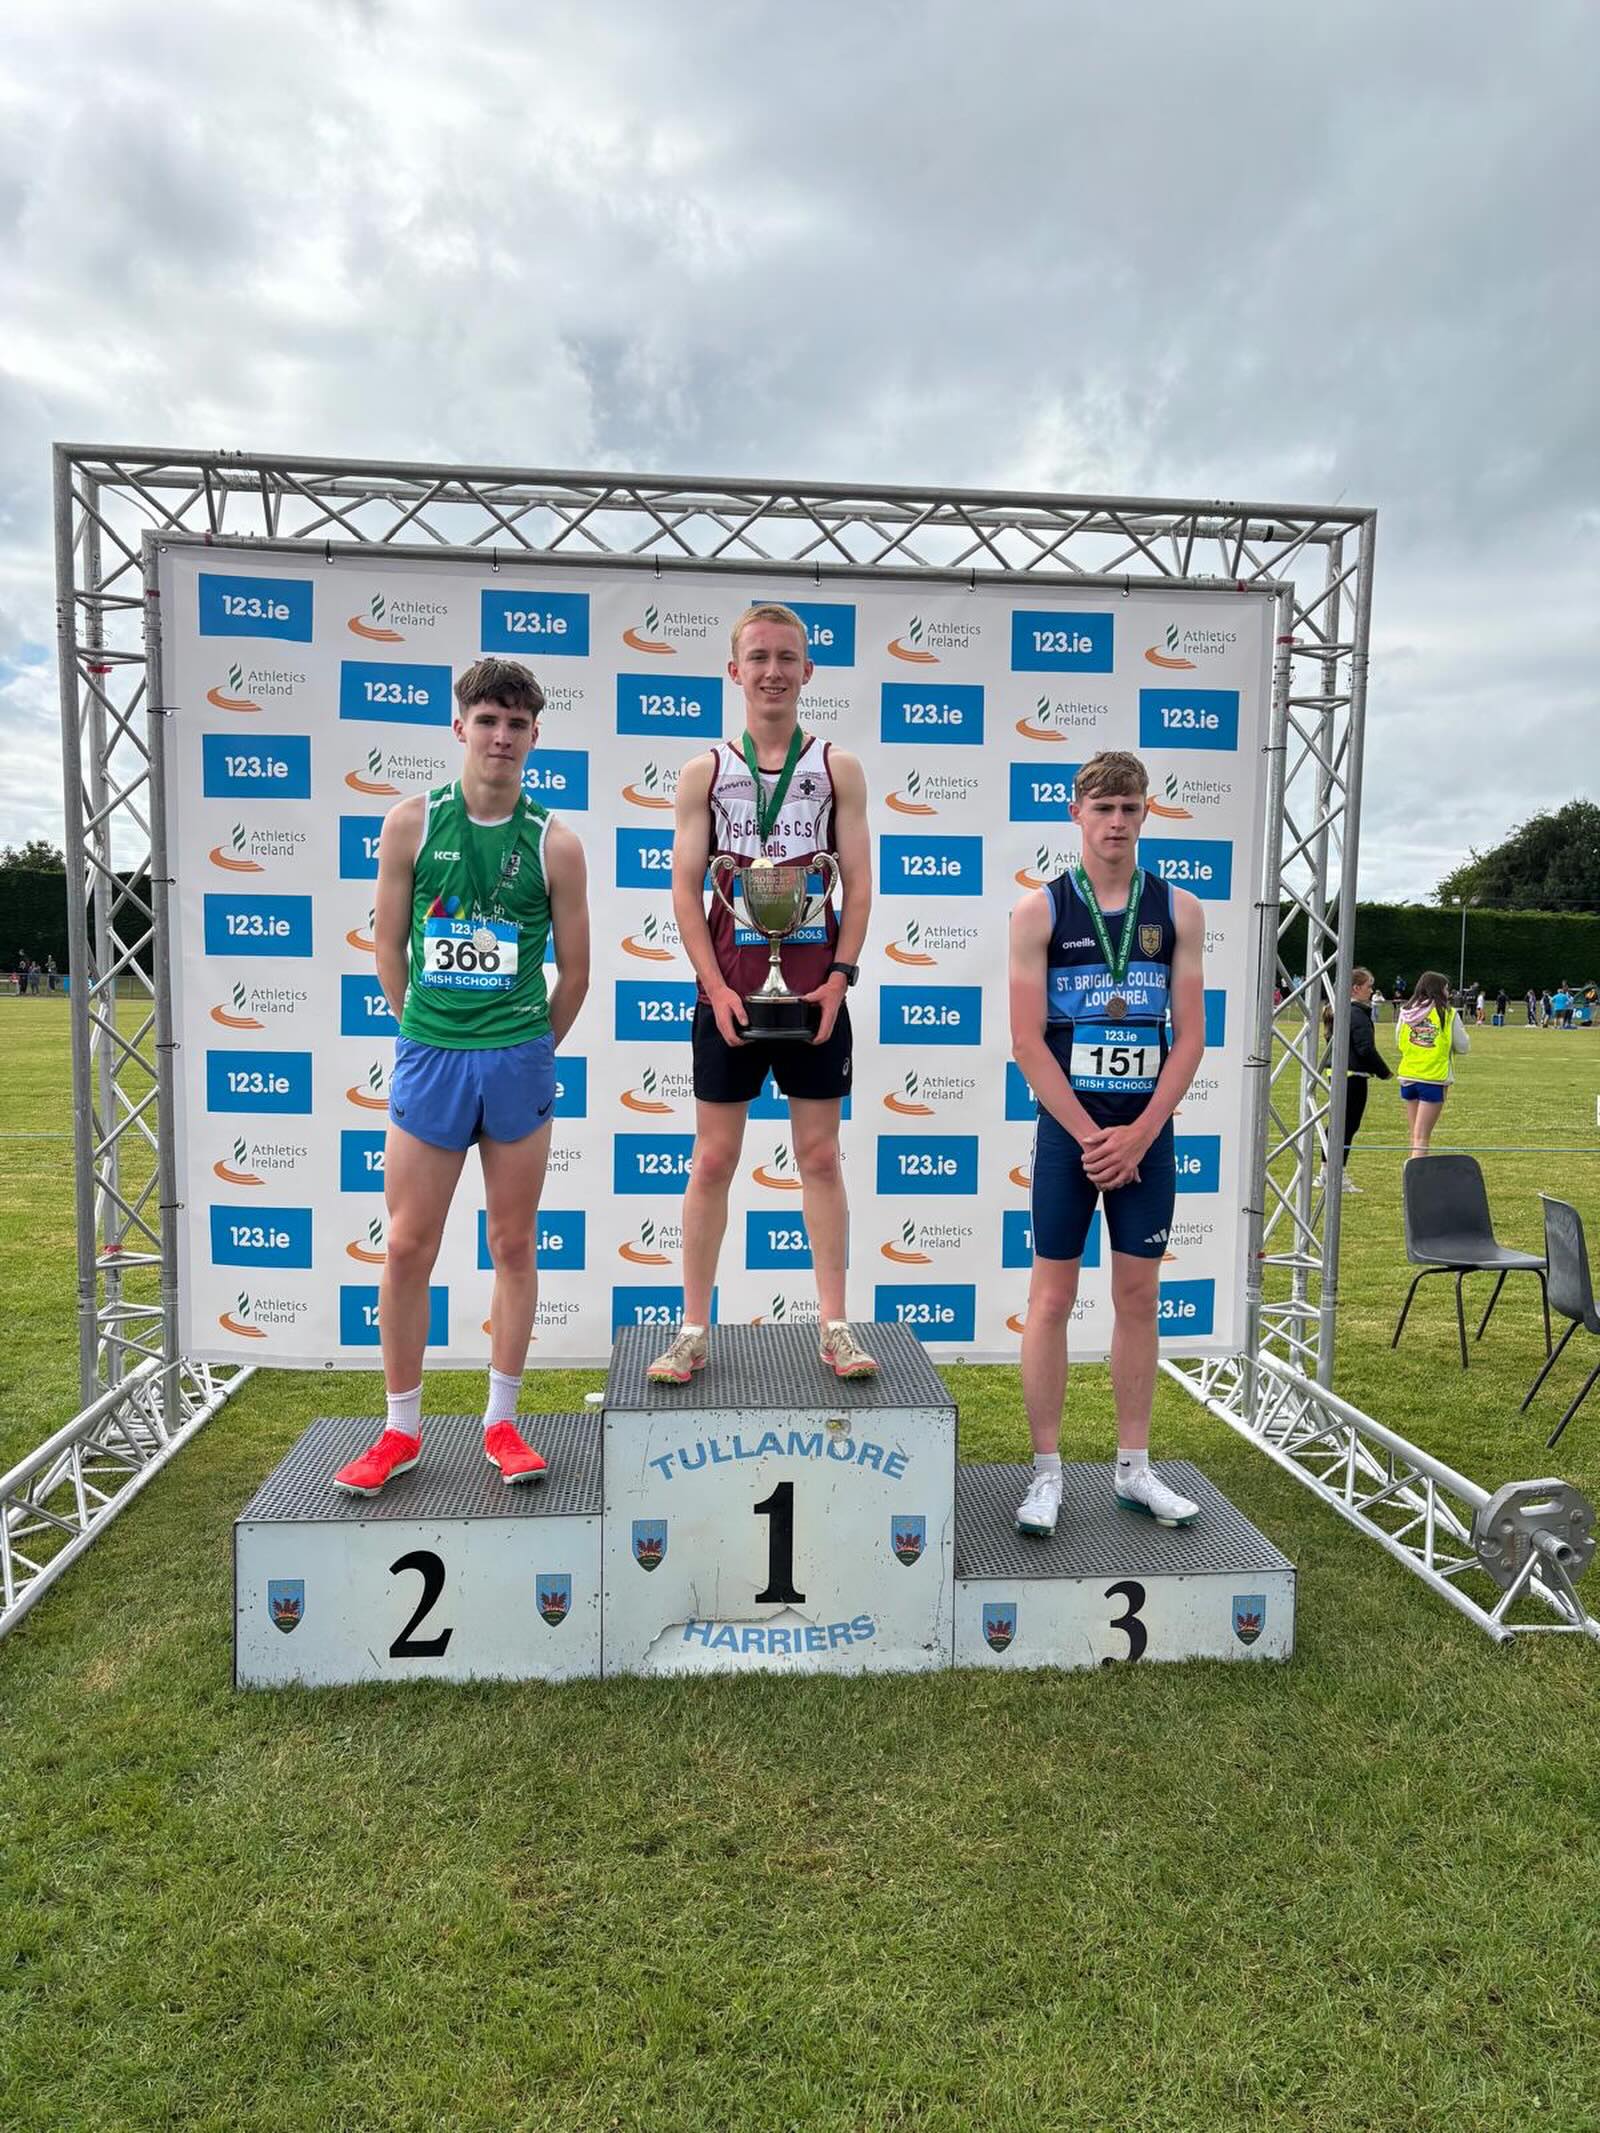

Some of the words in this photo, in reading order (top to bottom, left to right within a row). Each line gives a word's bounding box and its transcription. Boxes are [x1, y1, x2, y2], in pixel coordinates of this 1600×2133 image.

[222, 595, 290, 620] 123.ie
[390, 601, 448, 615] Athletics
[390, 615, 435, 626] Ireland
[504, 611, 568, 634] 123.ie
[663, 612, 719, 626] Athletics
[663, 626, 707, 638] Ireland
[808, 624, 834, 645] .ie
[927, 622, 981, 635] Athletics
[927, 636, 969, 648] Ireland
[1032, 631, 1093, 653] 123.ie
[1183, 630, 1237, 642] Athletics
[1183, 643, 1225, 654] Ireland
[248, 671, 306, 684] Athletics
[248, 684, 293, 696] Ireland
[364, 682, 429, 705] 123.ie
[544, 686, 585, 699] hletics
[639, 695, 701, 717] 123.ie
[1055, 703, 1108, 715] Athletics
[799, 709, 838, 721] reland
[902, 703, 963, 725] 123.ie
[1161, 708, 1220, 729] 123.ie
[1055, 715, 1097, 727] Ireland
[225, 756, 289, 778] 123.ie
[387, 755, 446, 768] Athletics
[387, 768, 433, 780] Ireland
[925, 776, 978, 788] Athletics
[1182, 780, 1232, 793] Athletics
[925, 788, 967, 800] Ireland
[1031, 783, 1075, 803] 123.i
[1182, 793, 1220, 805] Ireland
[745, 819, 791, 836] Cian's
[251, 830, 306, 843] Athletics
[251, 844, 294, 856] Ireland
[434, 851, 461, 861] KCS
[638, 848, 674, 870] 123
[901, 856, 961, 877] 123.ie
[1158, 860, 1213, 881] 123.ie
[226, 915, 290, 936] 123.ie
[450, 922, 481, 936] 123.i
[924, 926, 978, 938] Athletics
[740, 932, 766, 942] IRIS
[924, 938, 966, 950] Ireland
[436, 939, 501, 973] 366
[424, 974, 452, 984] IRISH
[455, 975, 510, 986] SCHOOLS
[251, 988, 308, 1001] Athletics
[251, 1002, 294, 1013] Ireland
[638, 1001, 695, 1021] 123.ie
[901, 1005, 961, 1026] 123.ie
[1105, 1030, 1138, 1042] 123.ie
[1090, 1046, 1146, 1076] 151
[228, 1072, 290, 1094] 123.ie
[661, 1074, 694, 1086] Athle
[922, 1076, 976, 1088] Athletics
[1075, 1079, 1105, 1089] IRISH
[1107, 1080, 1153, 1090] SCHOOLS
[661, 1086, 695, 1097] Irelan
[922, 1089, 964, 1100] Ireland
[251, 1144, 308, 1157] Athletics
[252, 1157, 295, 1169] Ireland
[898, 1154, 958, 1175] 123.ie
[920, 1224, 973, 1236] Athletics
[230, 1226, 290, 1248] 123.ie
[537, 1231, 563, 1250] .ie
[768, 1230, 811, 1250] 123.
[920, 1238, 961, 1249] Ireland
[1169, 1234, 1203, 1246] reland
[254, 1299, 308, 1311] Athletics
[254, 1312, 296, 1324] Ireland
[534, 1313, 568, 1325] eland
[634, 1306, 684, 1325] 123.i
[895, 1303, 955, 1324] 123.ie
[648, 1431, 910, 1480] TULLAMORE
[753, 1481, 806, 1604] 1
[388, 1550, 454, 1658] 2
[1101, 1580, 1148, 1665] 3
[682, 1614, 876, 1655] HARRIERS
